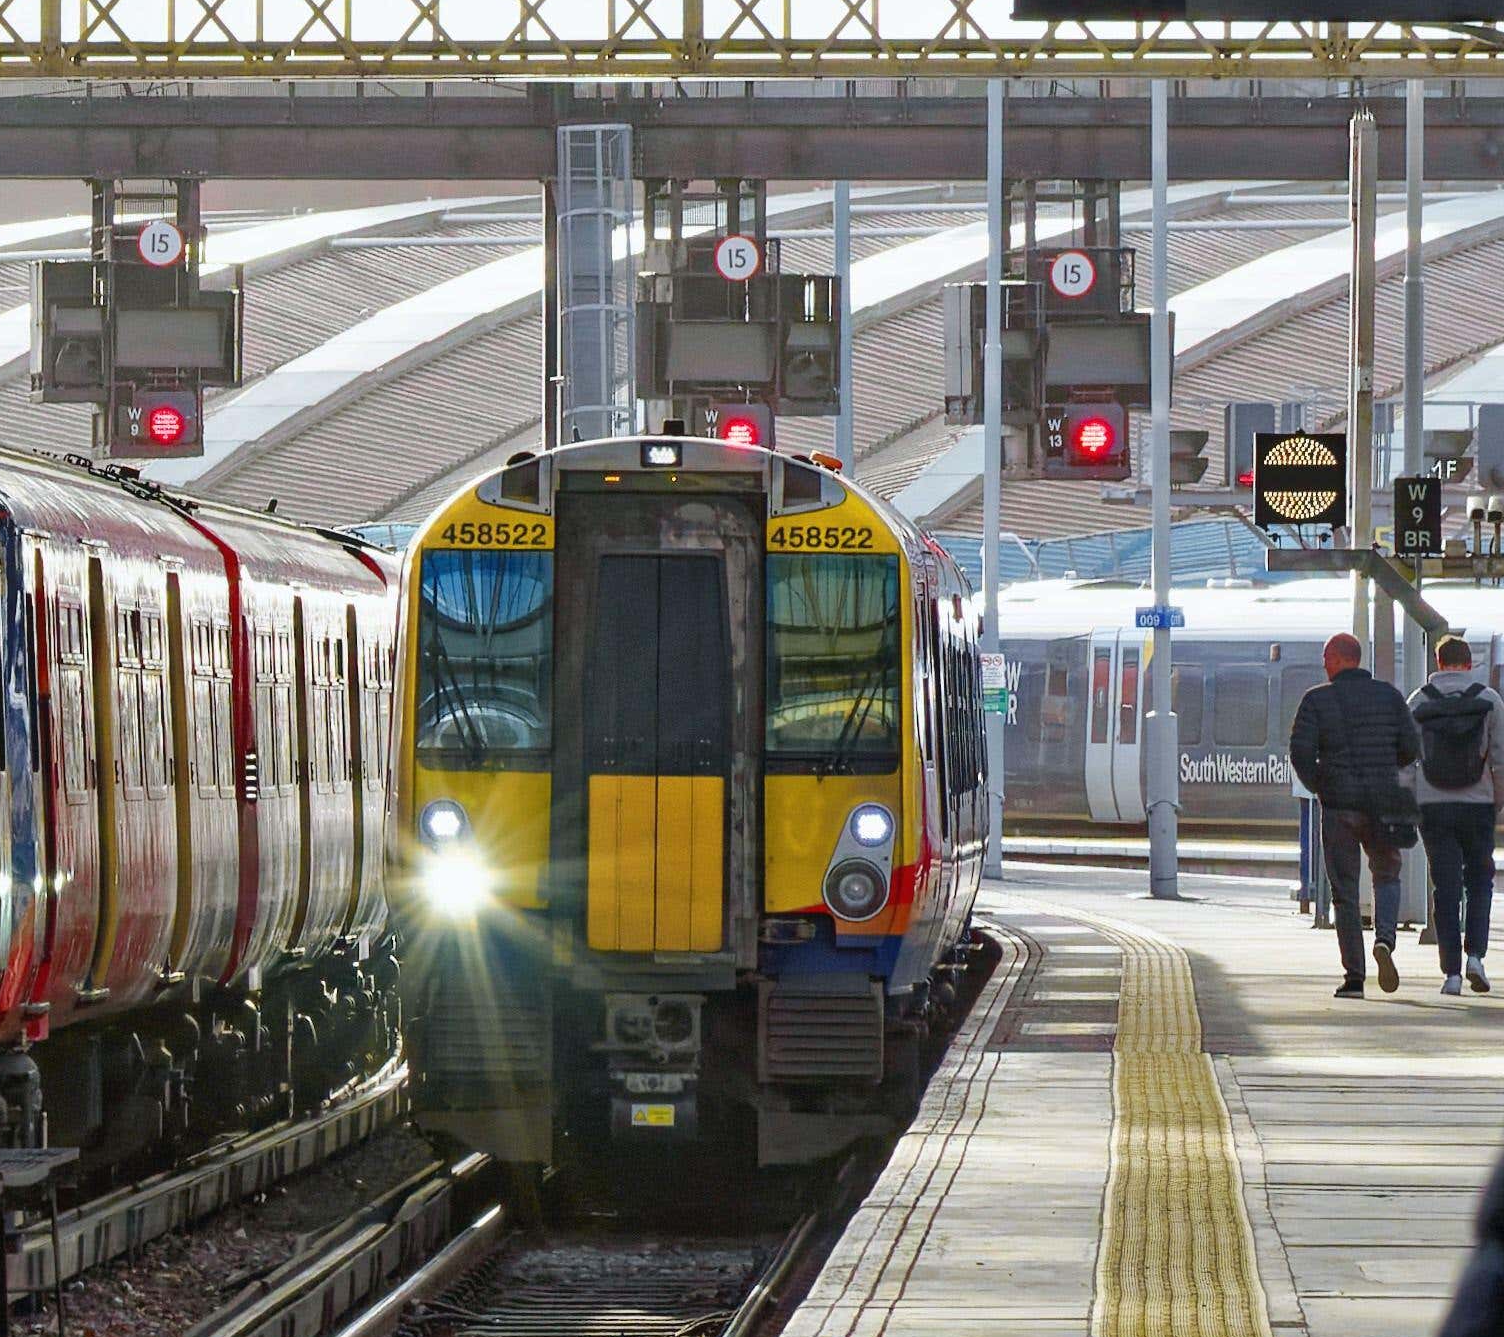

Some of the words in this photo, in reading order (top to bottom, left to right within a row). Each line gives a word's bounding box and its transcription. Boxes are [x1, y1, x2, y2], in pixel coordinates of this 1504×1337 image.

[152, 232, 169, 254] 15
[728, 248, 747, 269] 15
[1063, 264, 1081, 284] 15
[127, 406, 142, 421] W
[704, 410, 719, 423] W
[1047, 418, 1062, 432] W
[1048, 434, 1063, 448] 13
[1408, 483, 1428, 501] W
[1412, 506, 1424, 525] 9
[441, 523, 547, 545] 458522
[770, 526, 874, 550] 458522
[1404, 530, 1431, 548] BR
[1180, 752, 1216, 783] South
[1216, 753, 1267, 784] Western
[1268, 753, 1293, 784] Rail
